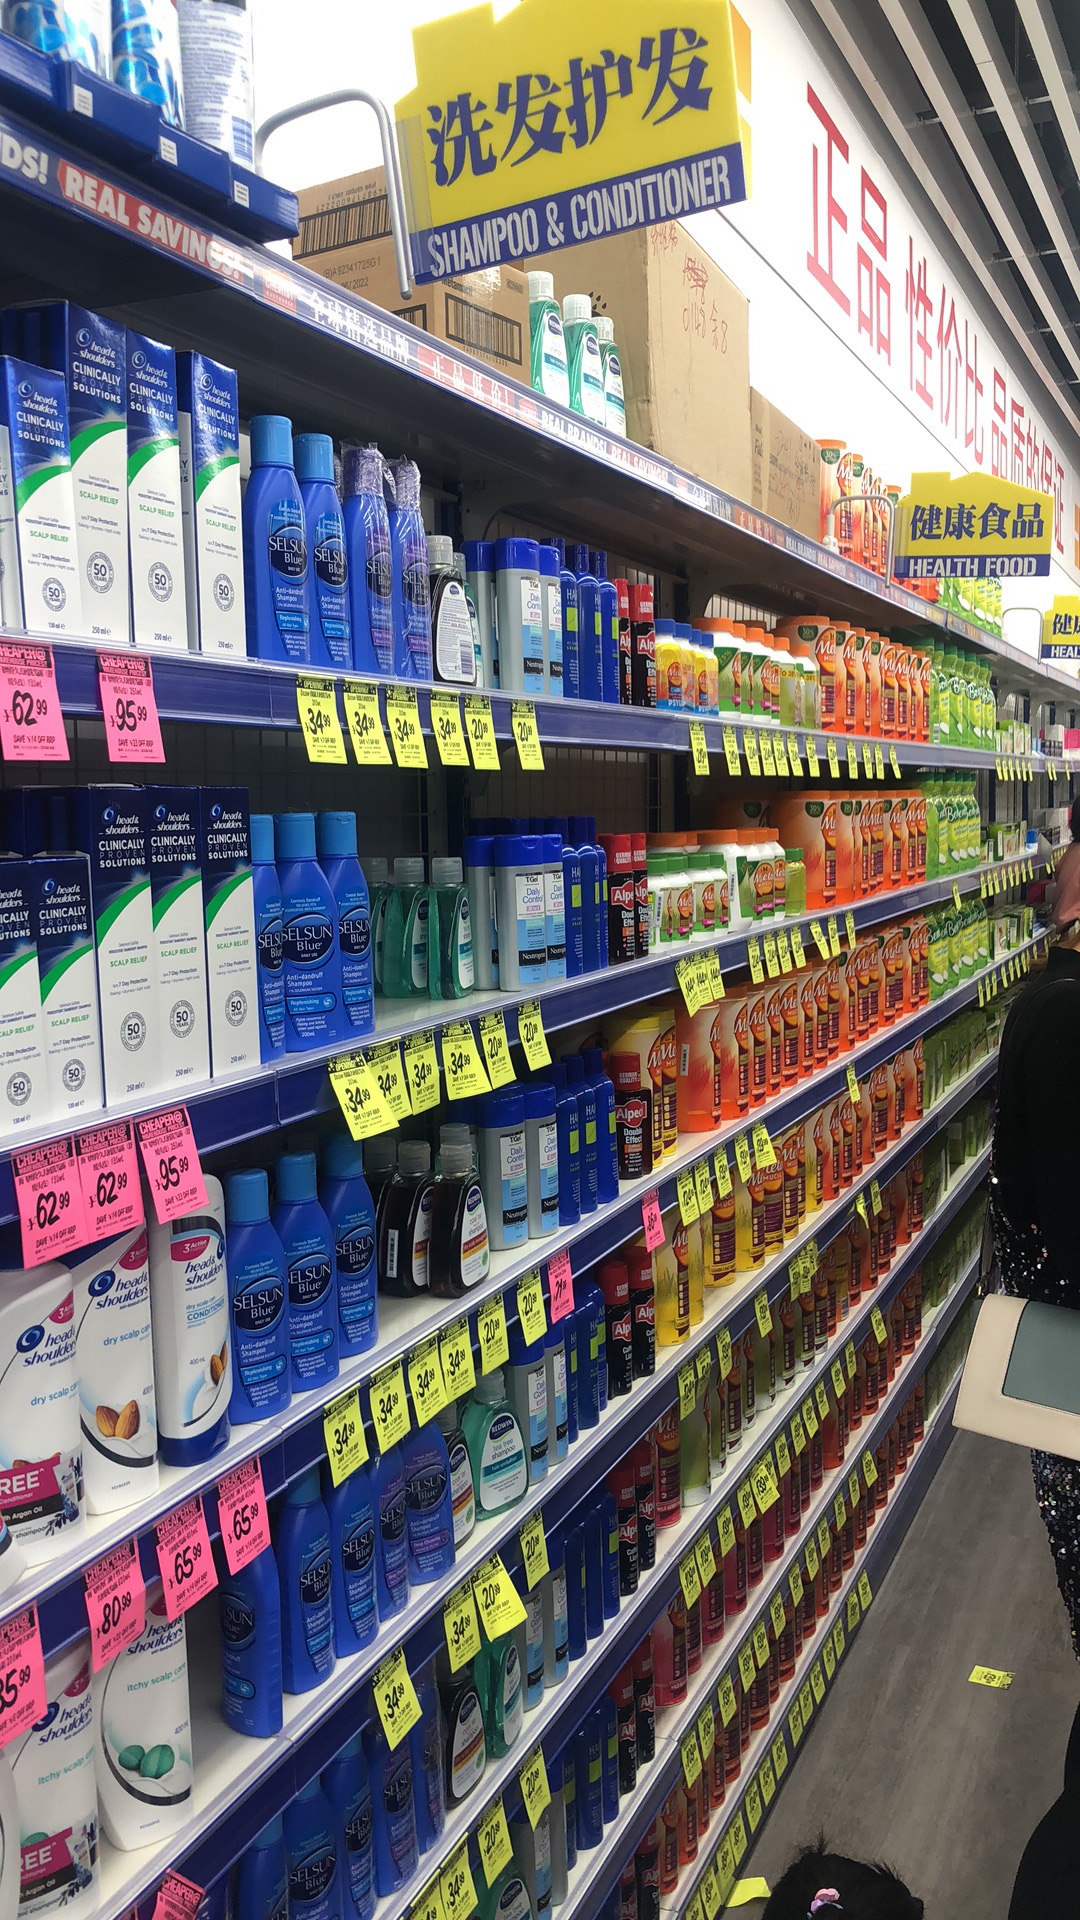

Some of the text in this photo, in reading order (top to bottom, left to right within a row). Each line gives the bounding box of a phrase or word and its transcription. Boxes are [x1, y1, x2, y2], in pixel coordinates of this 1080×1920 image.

[427, 27, 714, 188] 洗发护发
[64, 165, 129, 228] REAL
[427, 208, 540, 278] SHAMPOO
[546, 201, 566, 247] &
[570, 155, 731, 240] CONDITIONER
[73, 361, 121, 386] CLINICALLY
[73, 382, 121, 404] SOLUTIONS
[129, 383, 173, 405] CLINICALLY
[130, 402, 174, 422] SOLUTIONS
[198, 403, 235, 426] CLINICALLY
[16, 411, 64, 432] CLINICALLY
[541, 410, 567, 434] REAL
[199, 420, 236, 441] SOLUTIONS
[17, 430, 65, 448] SOLUTIONS
[79, 490, 119, 506] SCALP RELIEF
[909, 502, 1044, 541] 健康食品
[94, 564, 107, 576] 50
[909, 556, 1037, 577] HEALTH FOOD
[154, 574, 167, 585] 50
[48, 587, 60, 598] 50
[219, 584, 229, 596] 50
[1051, 645, 1080, 658] HEAL
[105, 824, 140, 835] shoulders
[157, 821, 190, 831] shoulders
[213, 820, 243, 830] shoulders
[99, 838, 145, 851] CLINICALLY
[150, 834, 196, 847] CLINICALLY
[207, 832, 247, 845] CLINICALLY
[151, 852, 197, 863] SOLUTIONS
[208, 849, 248, 861] SOLUTIONS
[100, 857, 146, 868] SOLUTIONS
[45, 894, 80, 905] shoulders
[39, 905, 87, 921] CLINICALLY
[40, 923, 88, 936] SOLUTIONS
[350, 933, 367, 943] Blue
[161, 946, 197, 958] SCALP RELIEF
[297, 941, 321, 952] Blue
[110, 955, 148, 968] SCALP RELIEF
[288, 980, 313, 988] Shampoo
[231, 1000, 242, 1011] 50
[52, 1013, 90, 1028] SCALP RELIEF
[176, 1010, 188, 1022] 50
[127, 1023, 140, 1035] 50
[68, 1068, 80, 1079] 50
[349, 1252, 368, 1263] Blue
[185, 1262, 224, 1286] shoulders
[298, 1281, 322, 1293] Blue
[95, 1285, 149, 1310] shoulders
[233, 1285, 284, 1312] SELSUN
[251, 1305, 276, 1318] Blue
[103, 1330, 140, 1347] dry scalp
[30, 1387, 69, 1407] dry scalp
[491, 1418, 513, 1434] REDWIN
[491, 1445, 516, 1460] shampoo
[12, 1506, 43, 1521] Argan Oil
[126, 1627, 183, 1656] shoulders
[151, 1672, 173, 1686] scalp
